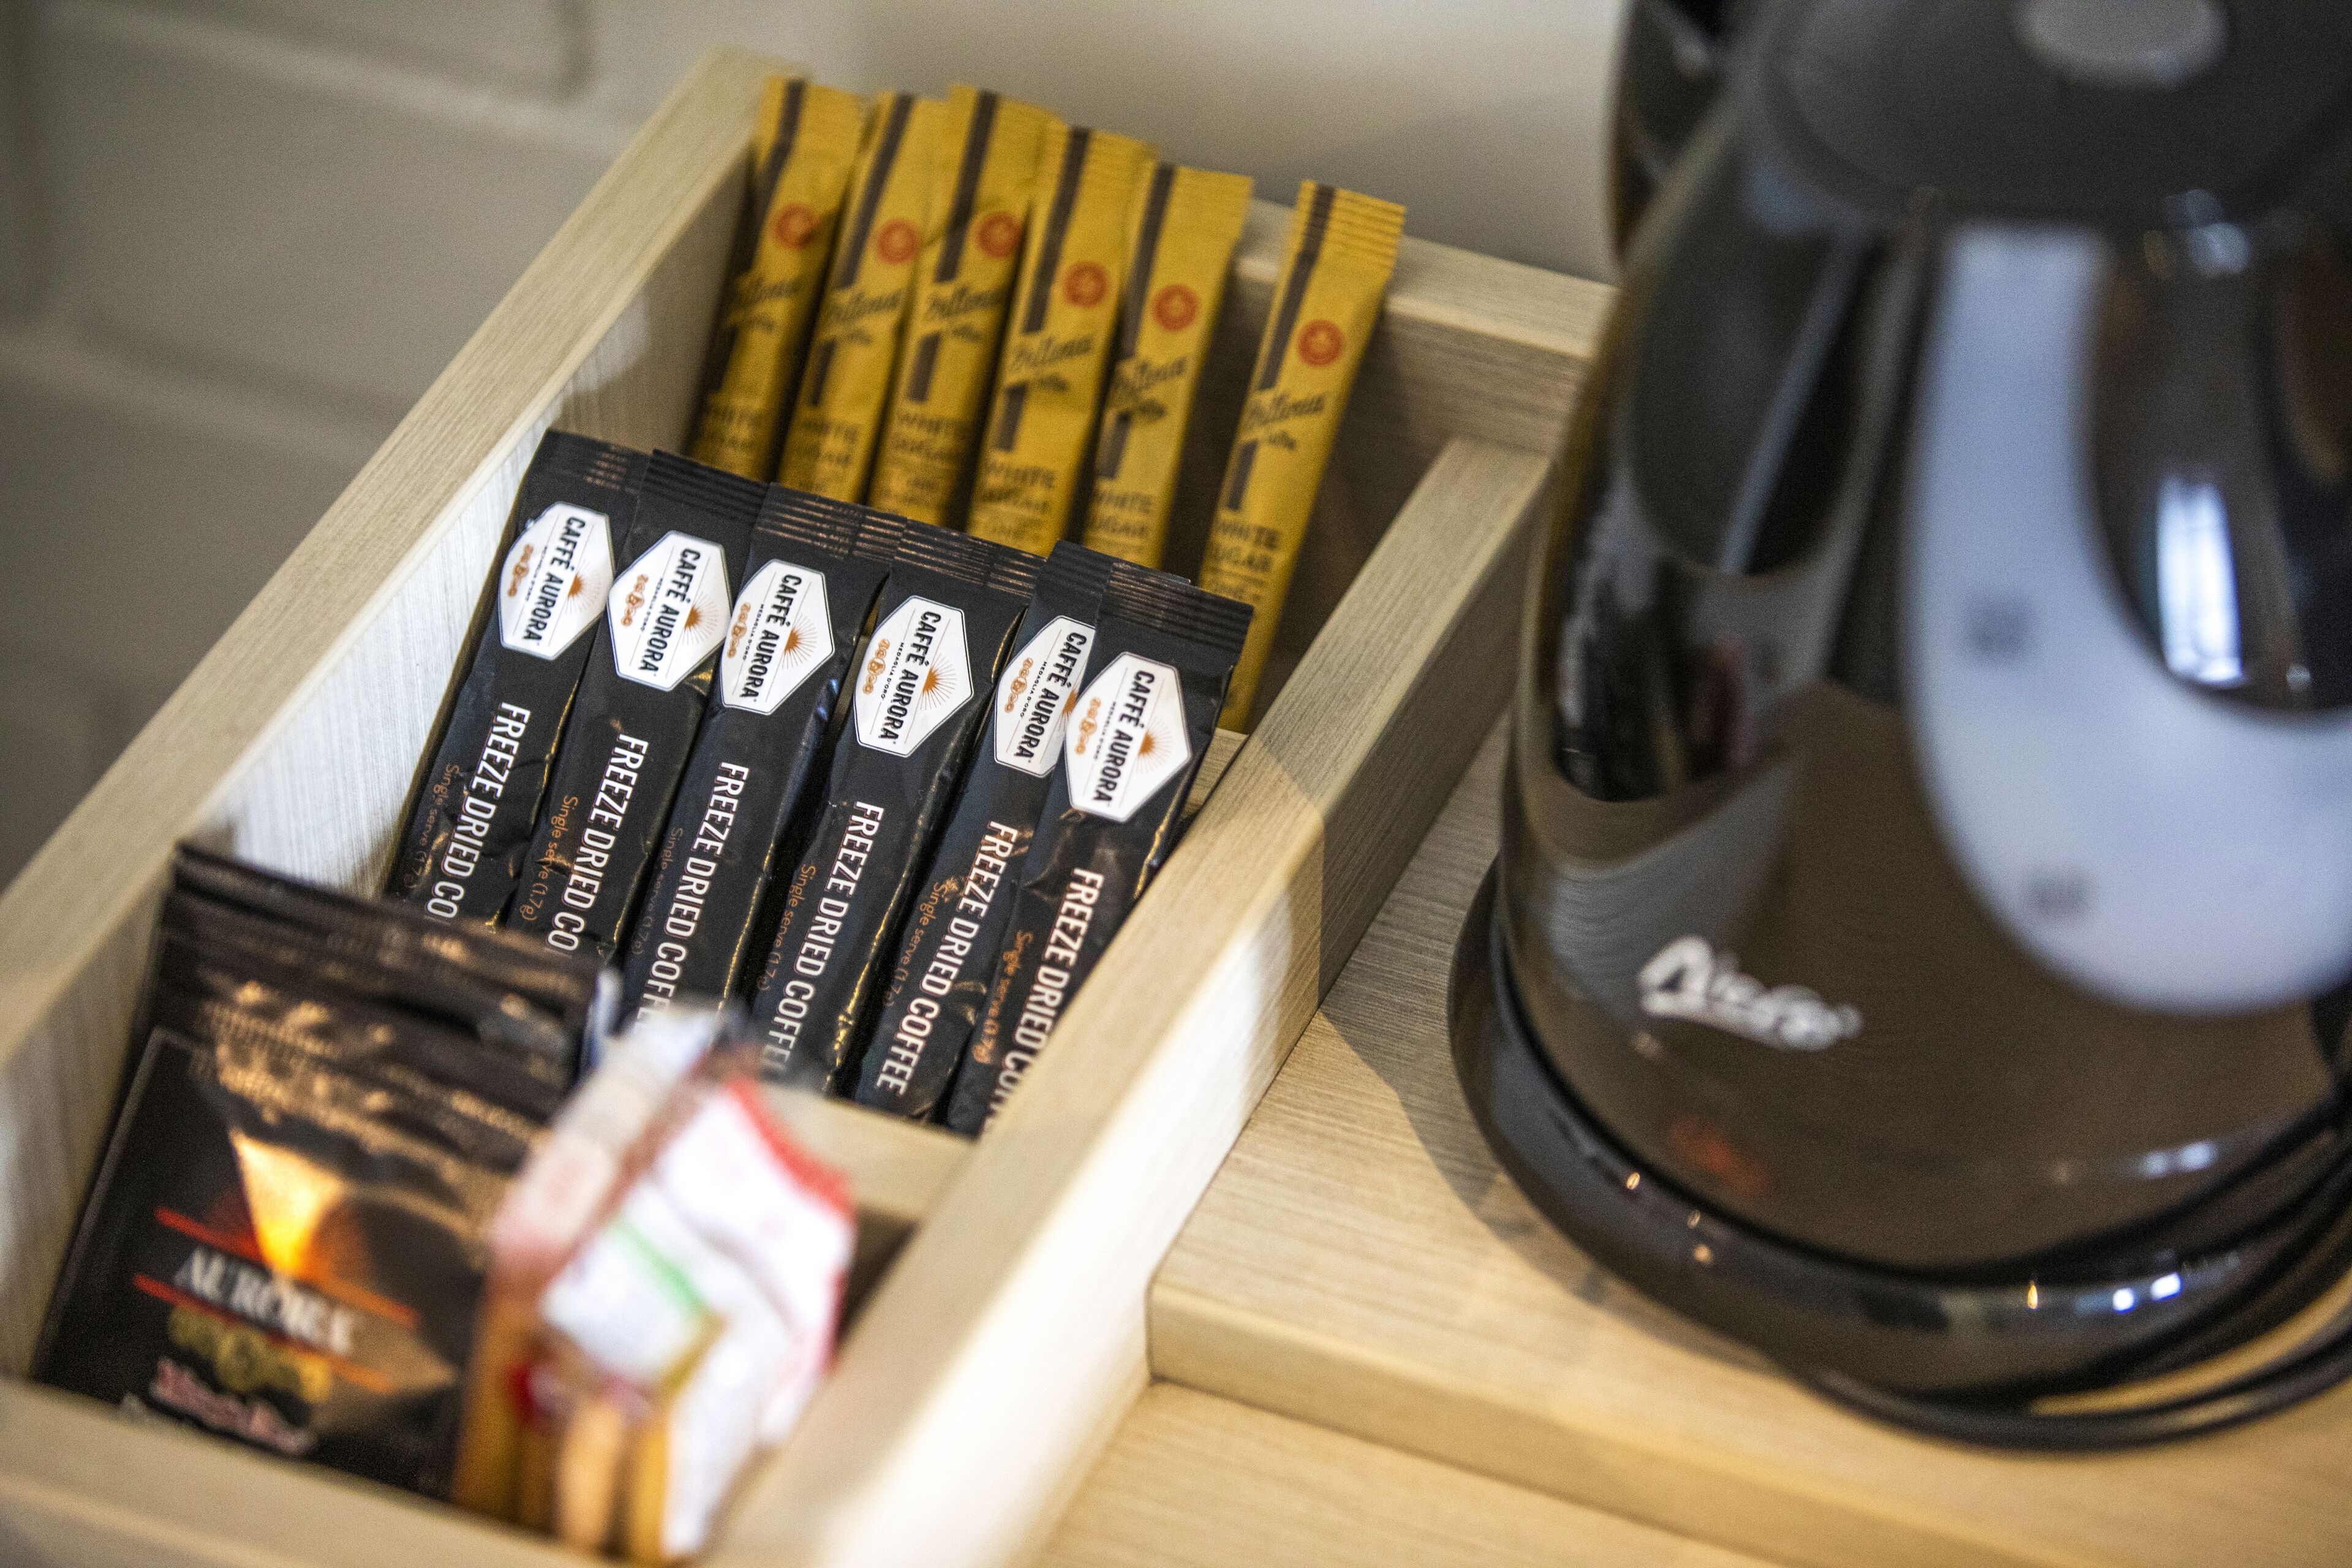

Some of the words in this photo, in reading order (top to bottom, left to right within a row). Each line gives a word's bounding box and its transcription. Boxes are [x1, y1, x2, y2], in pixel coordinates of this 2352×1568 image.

[522, 571, 564, 641] AURORA
[638, 605, 679, 673] AURORA
[750, 603, 764, 637] MEDAGLIA
[739, 630, 780, 698] AURORA
[742, 639, 753, 662] D'ORO
[890, 642, 905, 676] MEDAGLIA
[1030, 661, 1047, 695] MEDAGLIA
[878, 669, 919, 740] AURORA
[881, 677, 892, 699] D'ORO
[1020, 696, 1033, 718] D'ORO
[471, 702, 532, 797] FREEZE
[1014, 688, 1060, 758] AURORA
[590, 734, 649, 829] FREEZE
[1092, 729, 1134, 802] AURORA
[444, 796, 497, 878] DRIED
[552, 795, 578, 840] Single
[692, 762, 749, 855] FREEZE
[538, 840, 559, 880] serve
[563, 829, 616, 909] DRIED
[661, 829, 684, 871] Single
[827, 801, 884, 895] FREEZE
[958, 821, 1018, 918] FREEZE
[425, 881, 465, 926] CO
[519, 881, 548, 920] (1.7g)
[665, 856, 716, 937] DRIED
[790, 864, 816, 907] Single
[919, 881, 949, 926] Single
[1045, 867, 1104, 967] FREEZE
[544, 911, 585, 957] CO
[774, 907, 797, 949] serve
[796, 898, 849, 976] DRIED
[902, 927, 924, 966] serve
[922, 917, 979, 997] DRIED
[635, 942, 687, 1031] COFF
[1015, 965, 1069, 1049] DRIED
[876, 997, 940, 1095] COFFEE
